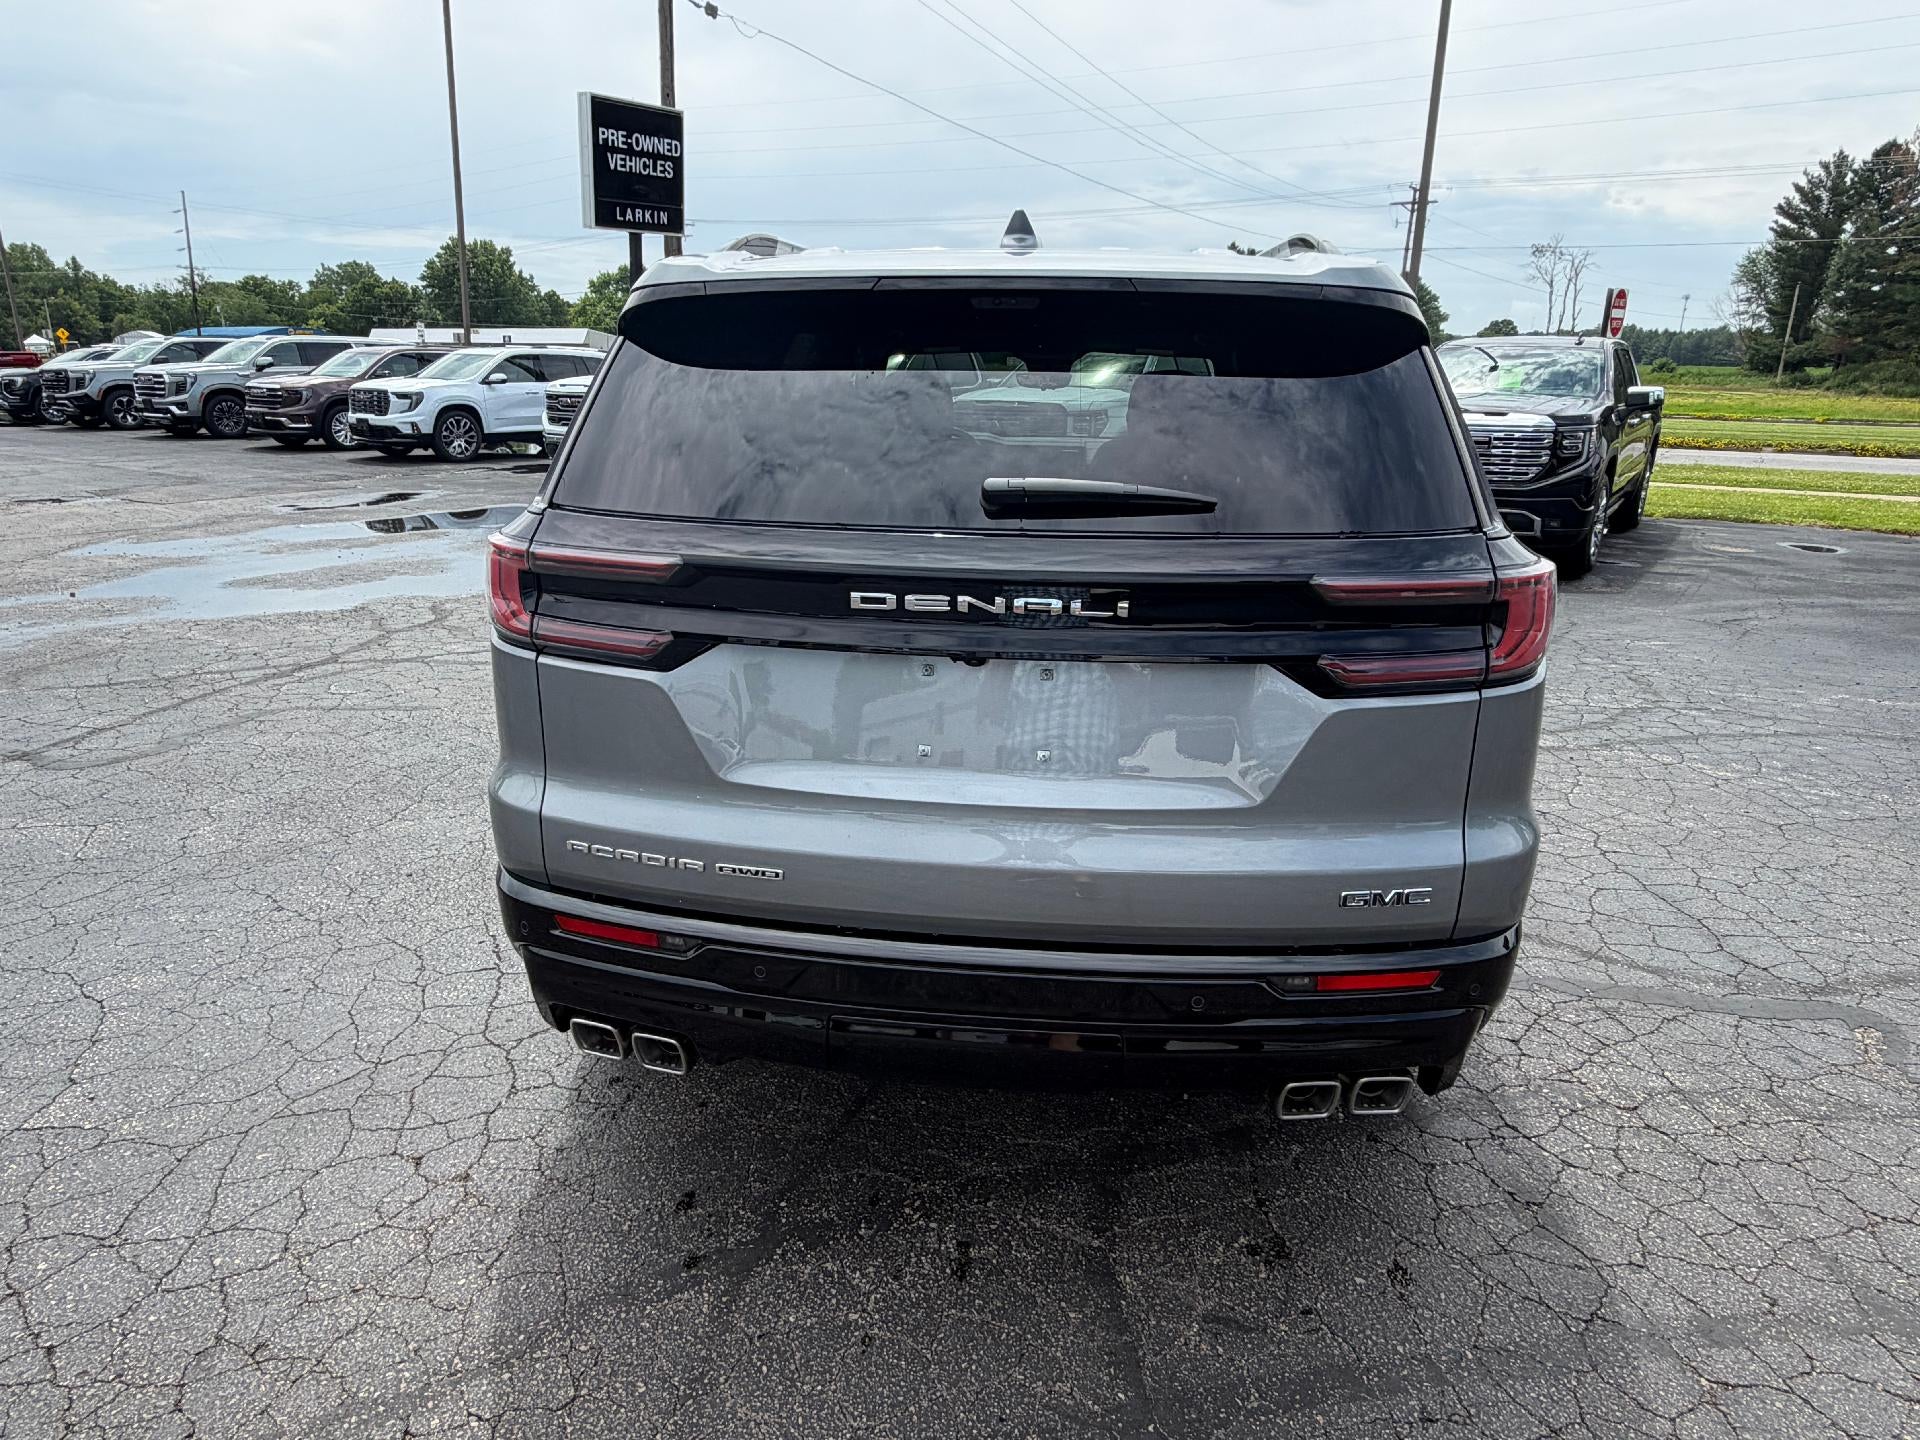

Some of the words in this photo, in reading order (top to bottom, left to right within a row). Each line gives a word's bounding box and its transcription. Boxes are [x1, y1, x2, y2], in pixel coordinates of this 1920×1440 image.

[598, 127, 680, 157] PRE-OWNED
[607, 152, 674, 179] VEHICLES
[616, 206, 668, 225] LARKIN
[850, 592, 1129, 618] DENALI
[566, 840, 705, 872] ACADIA
[715, 863, 784, 881] AWD
[1340, 887, 1432, 908] GMC
